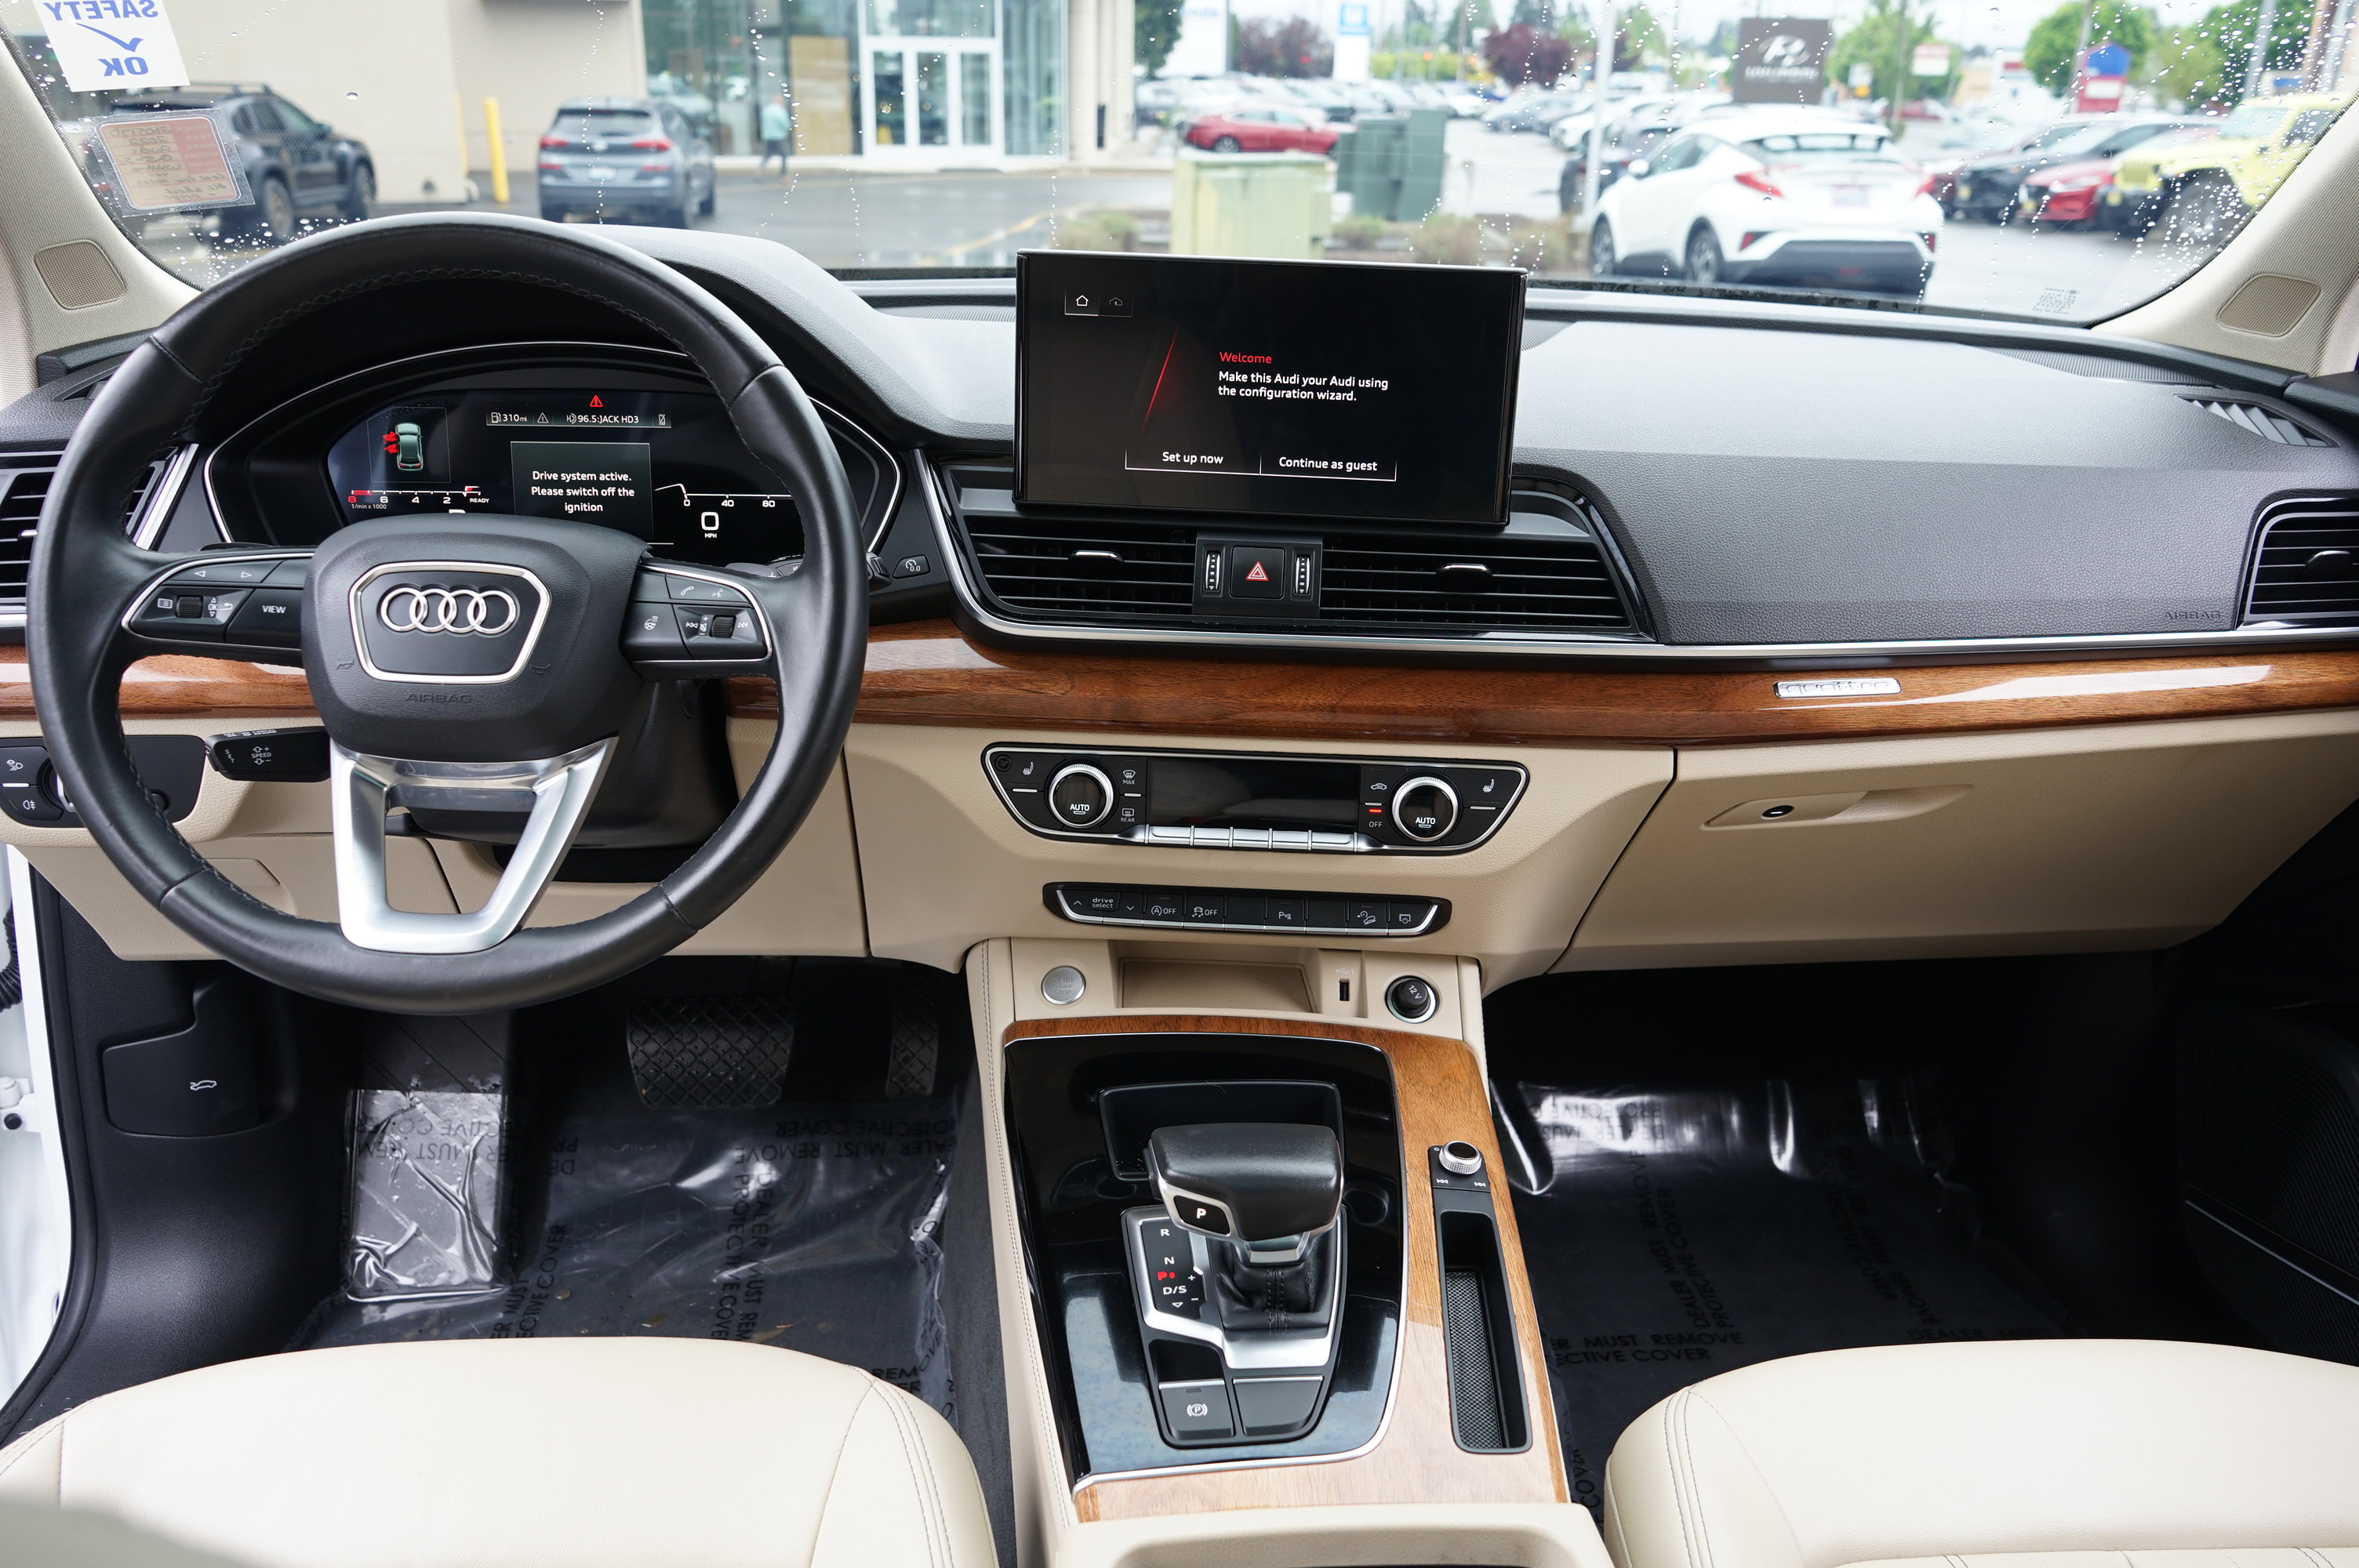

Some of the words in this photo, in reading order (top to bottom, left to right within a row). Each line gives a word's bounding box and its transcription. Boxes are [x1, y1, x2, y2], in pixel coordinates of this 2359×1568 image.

[1219, 352, 1272, 364] Welcome
[1219, 371, 1248, 383] Make
[1250, 372, 1271, 383] this
[1274, 373, 1299, 385] Audi
[1301, 376, 1328, 387] your
[1329, 376, 1355, 387] Audi
[1358, 377, 1389, 390] using
[1218, 385, 1236, 397] the
[1239, 387, 1314, 400] configuration
[1316, 390, 1357, 401] wizard.
[578, 415, 620, 423] 96.5:JACK
[1162, 451, 1180, 463] Set
[1183, 454, 1198, 465] up
[1200, 455, 1223, 464] now
[1278, 456, 1329, 469] Continue
[1331, 460, 1343, 470] as
[1346, 460, 1378, 472] guest
[533, 471, 558, 481] Drive
[561, 472, 597, 482] system
[599, 472, 632, 481] active.
[531, 486, 564, 496] Please
[566, 487, 598, 497] switch
[601, 487, 616, 496] off
[617, 488, 634, 497] the
[565, 502, 603, 514] ignition
[701, 511, 719, 531] 0
[2165, 612, 2220, 620] AIRBAG
[405, 692, 472, 703] AIRBAG
[834, 1141, 888, 1157] MUST
[1196, 1207, 1206, 1219] P
[1164, 1256, 1175, 1265] N
[1162, 1285, 1187, 1295] D/S
[1583, 1334, 1638, 1348] MUST
[1650, 1333, 1747, 1346] REMOVE
[1631, 1348, 1712, 1362] COVER
